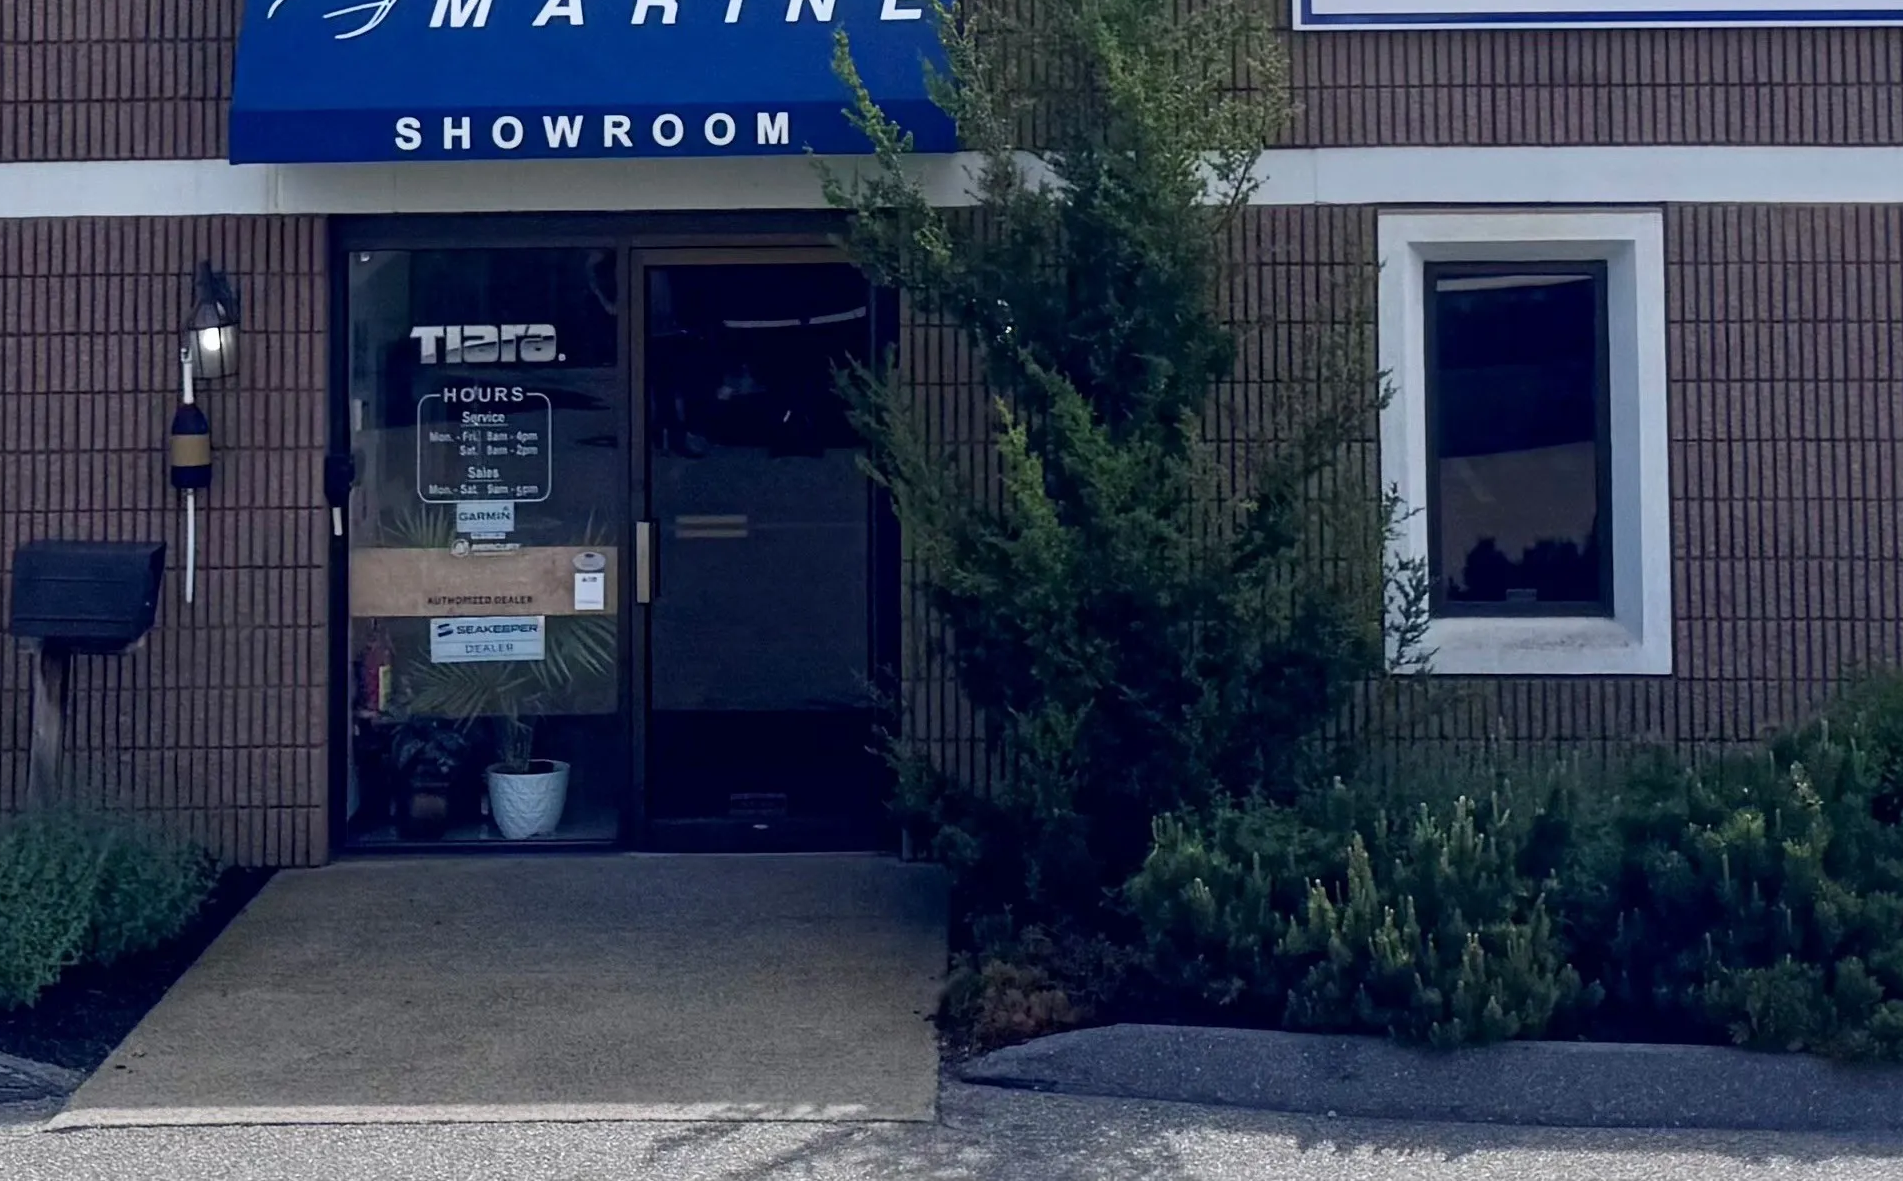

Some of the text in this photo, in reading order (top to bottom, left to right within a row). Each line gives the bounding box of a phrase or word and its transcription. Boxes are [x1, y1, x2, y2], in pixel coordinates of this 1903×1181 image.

[394, 111, 791, 151] SHOWROOM
[443, 386, 524, 403] HOURS
[461, 411, 506, 424] Service
[467, 466, 500, 479] Sales
[458, 511, 511, 521] GARMIN
[427, 595, 534, 606] AUTHORIZED DEALER
[456, 623, 539, 635] SEAKEEPER
[464, 643, 515, 654] DEALER
